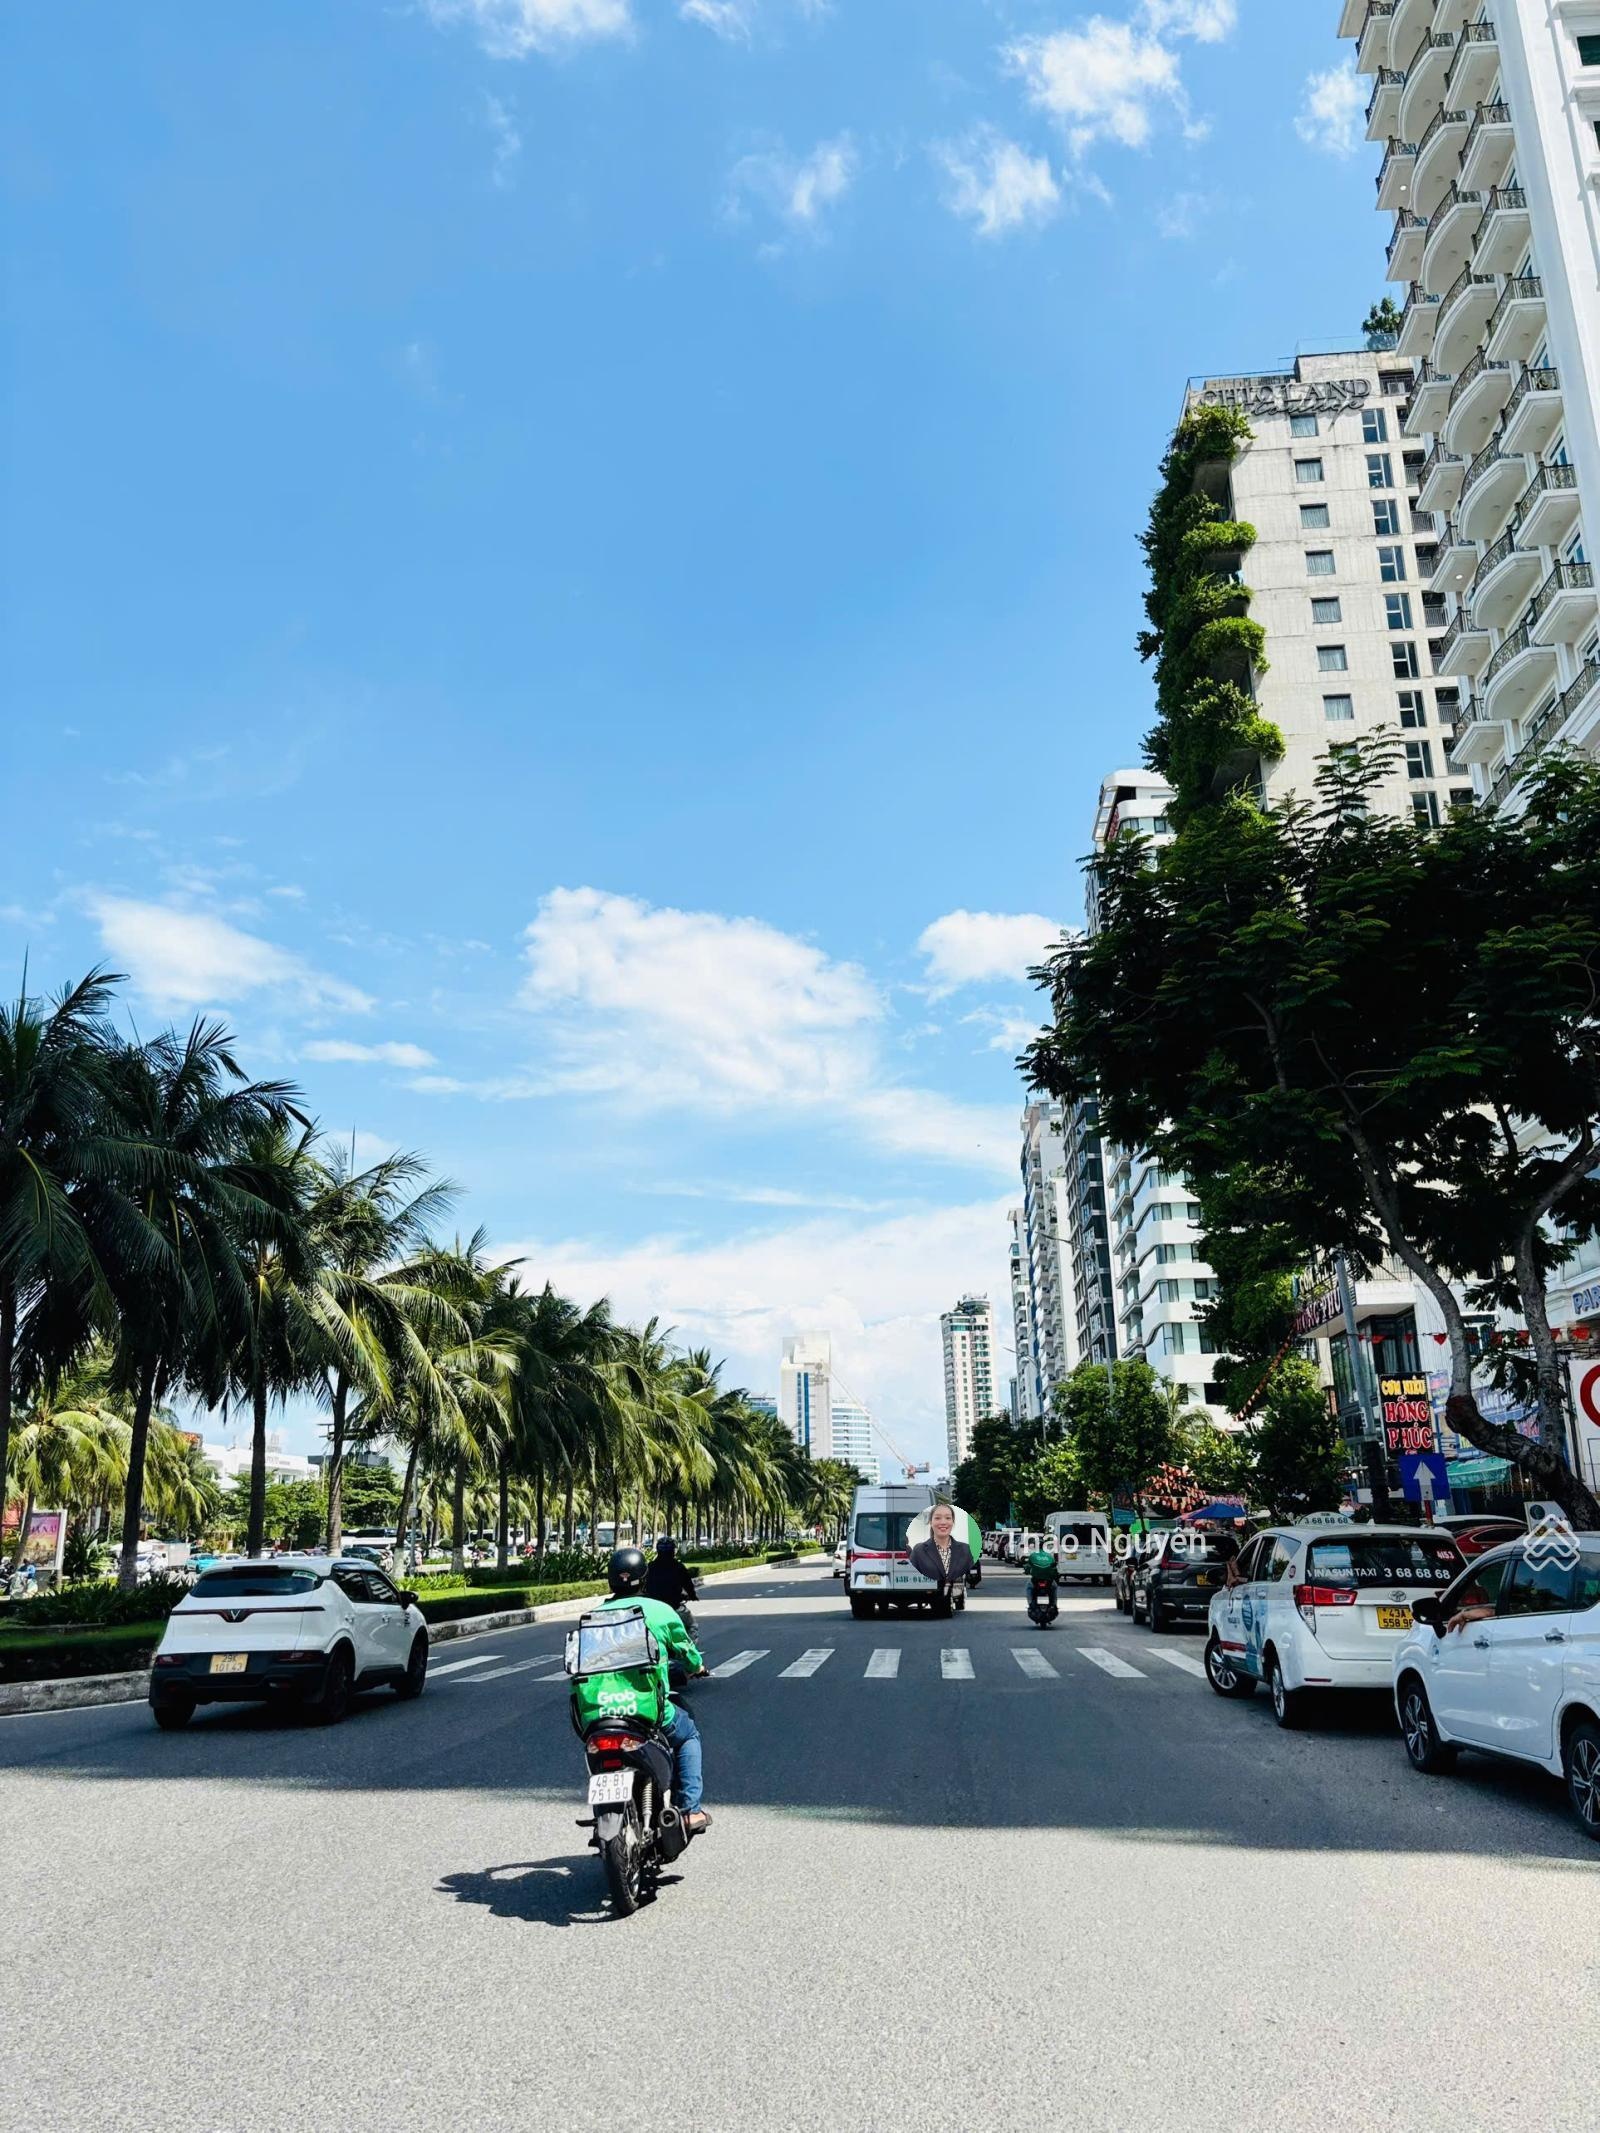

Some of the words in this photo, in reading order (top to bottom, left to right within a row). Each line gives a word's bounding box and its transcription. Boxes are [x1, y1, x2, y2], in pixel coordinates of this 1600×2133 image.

[1384, 1394, 1429, 1422] HỒNG
[1387, 1421, 1432, 1449] PHÚC
[1354, 1568, 1377, 1577] TAXI
[1384, 1567, 1393, 1578] 3
[1395, 1567, 1412, 1578] 68
[1415, 1568, 1432, 1579] 68
[1434, 1568, 1451, 1580] 68
[1389, 1608, 1407, 1618] 43A
[597, 1690, 636, 1704] Grab
